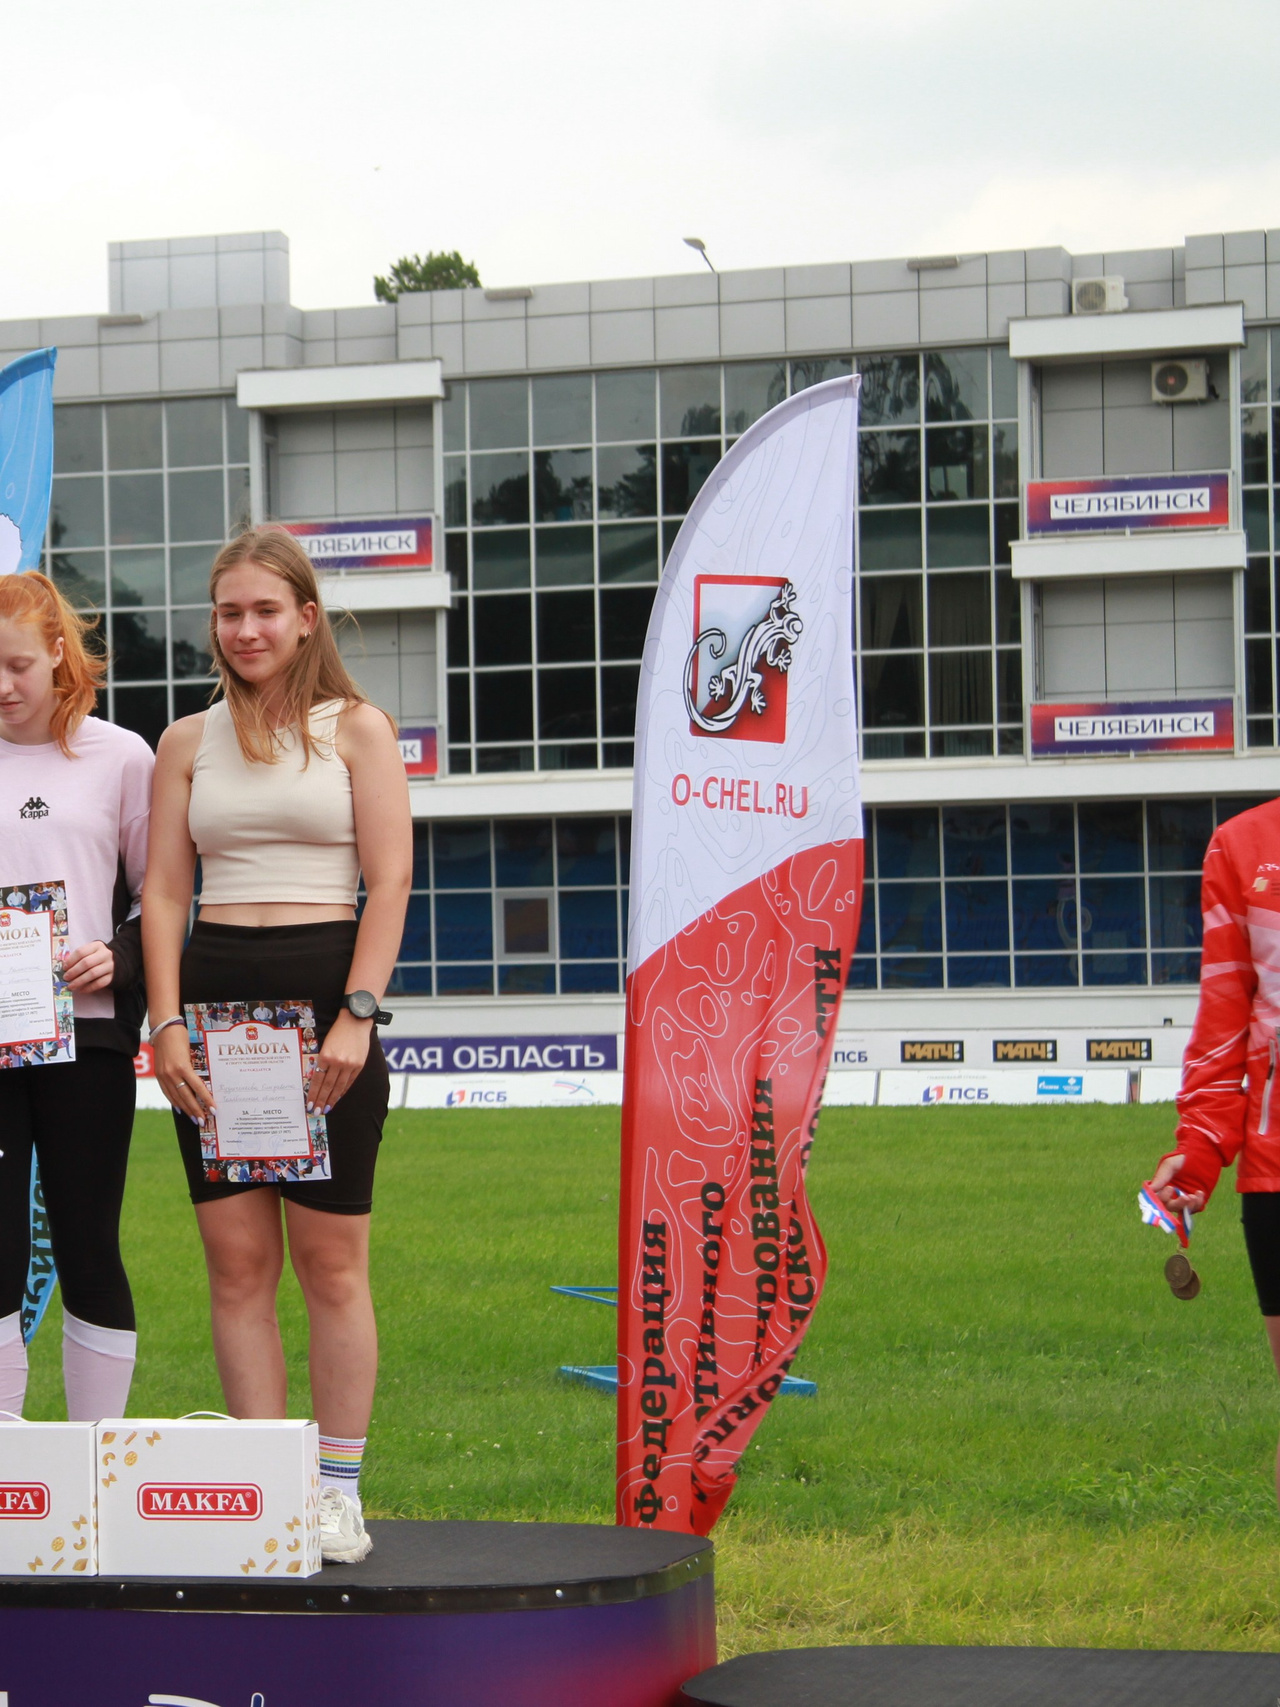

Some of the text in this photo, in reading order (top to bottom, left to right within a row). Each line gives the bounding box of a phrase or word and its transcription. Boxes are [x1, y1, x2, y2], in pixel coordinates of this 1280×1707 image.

[1054, 491, 1205, 515] ЧЕЛЯБИНСК
[302, 534, 412, 554] ЛЯБИНСК
[1058, 716, 1209, 736] ЧЕЛЯБИНСК
[671, 773, 809, 819] O-CHEL.RU
[20, 809, 49, 820] Kappa
[217, 1042, 290, 1056] ГРАМОТА
[386, 1044, 606, 1070] КАЯ ОБЛАСТЬ
[833, 1050, 869, 1064] ПСБ
[904, 1042, 960, 1061] МАТЧ!
[996, 1041, 1053, 1060] МАТЧ!
[1091, 1041, 1148, 1059] МАТЧ!
[470, 1090, 508, 1103] ПСБ
[949, 1087, 989, 1100] ПСБ
[634, 1219, 677, 1524] Федерация
[150, 1492, 250, 1511] MAKFA
